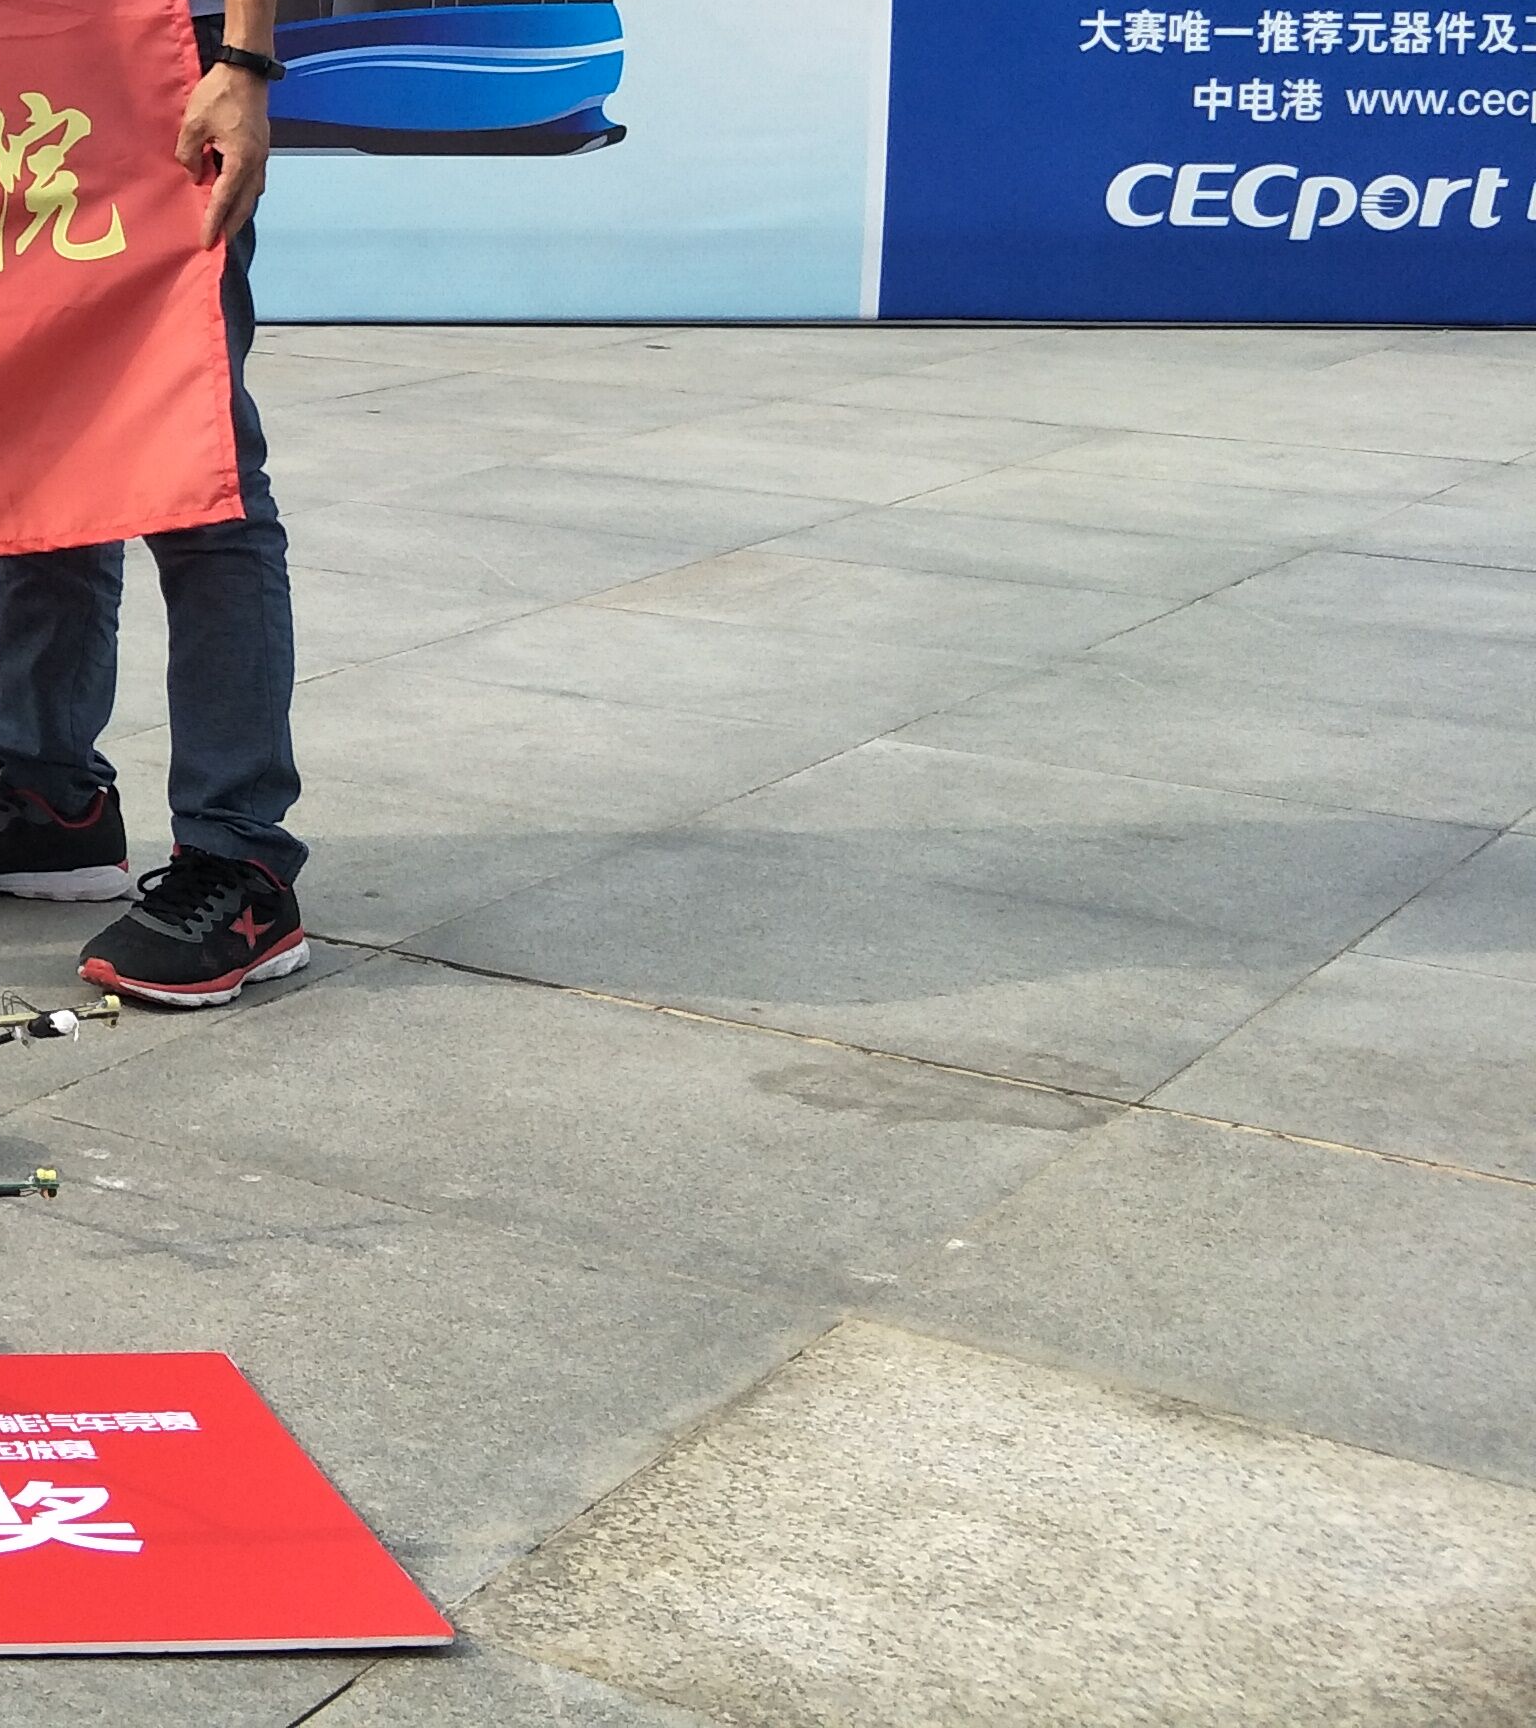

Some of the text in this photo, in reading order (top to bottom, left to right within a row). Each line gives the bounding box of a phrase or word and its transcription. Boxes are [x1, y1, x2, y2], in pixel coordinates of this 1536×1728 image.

[1192, 77, 1536, 123] 中电港 www.cec
[1105, 162, 1509, 242] CECport
